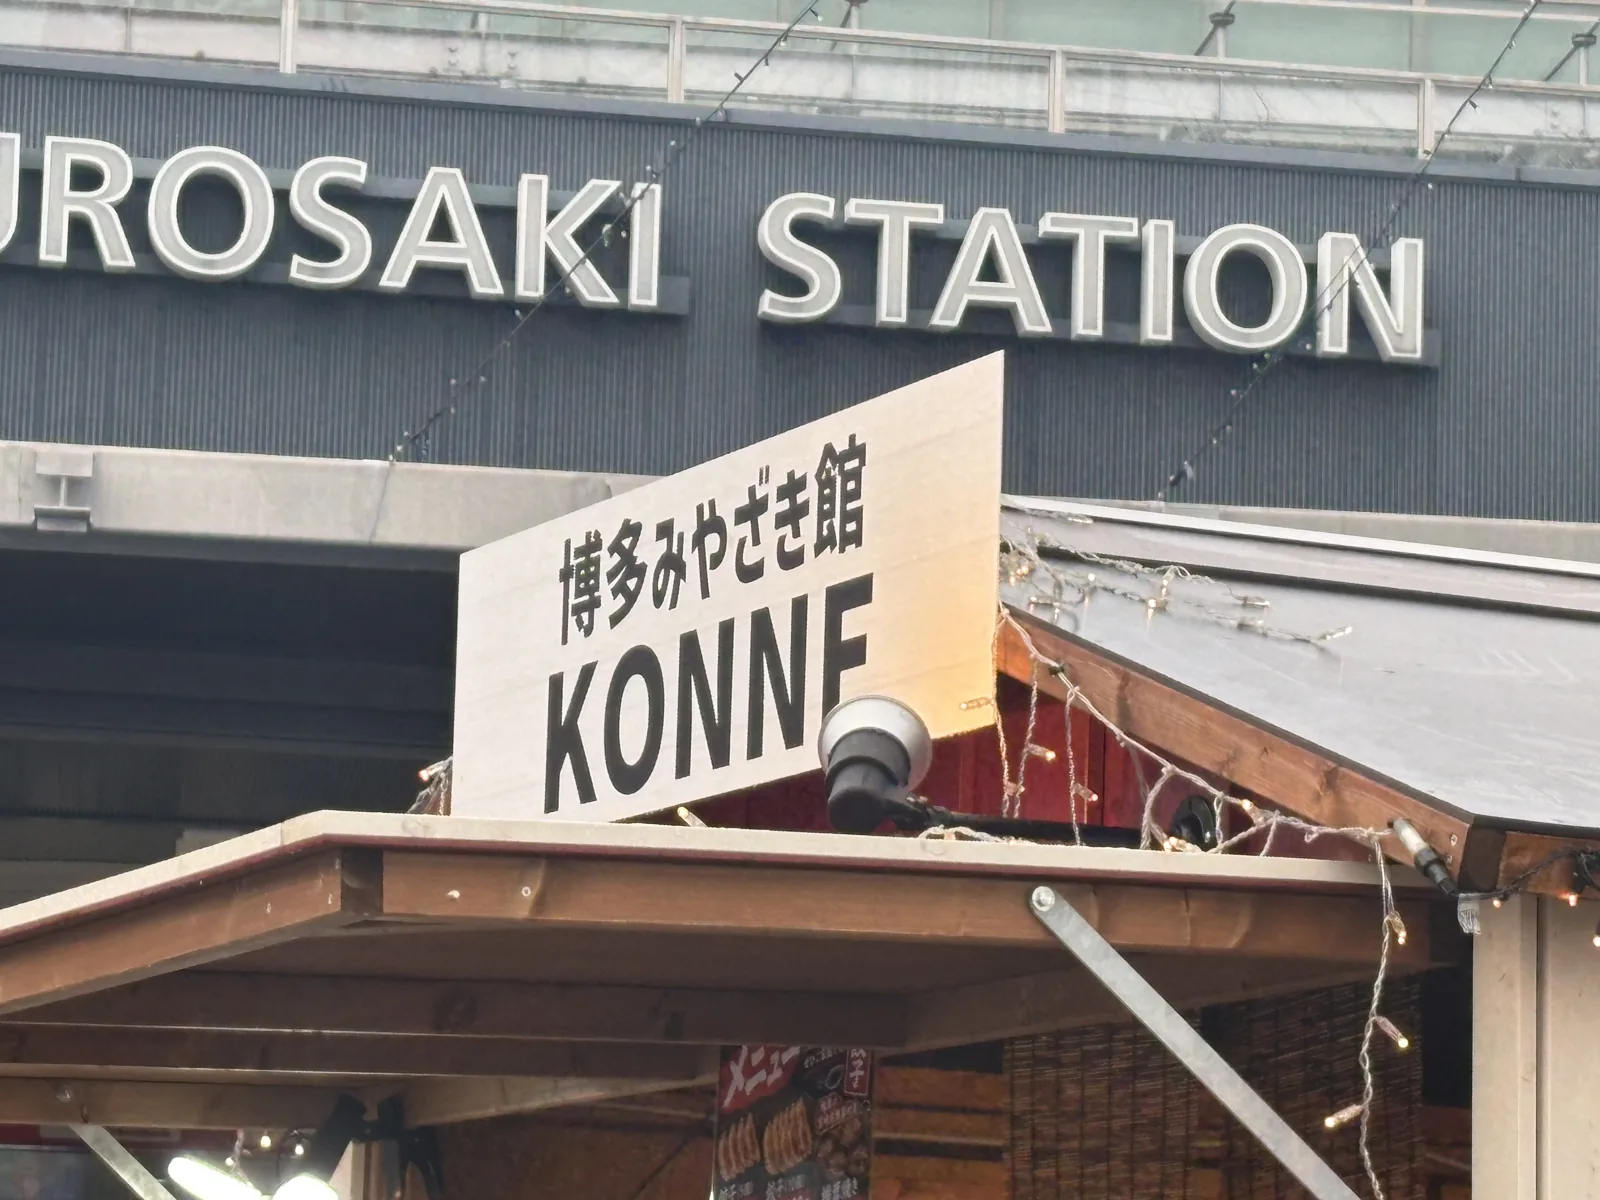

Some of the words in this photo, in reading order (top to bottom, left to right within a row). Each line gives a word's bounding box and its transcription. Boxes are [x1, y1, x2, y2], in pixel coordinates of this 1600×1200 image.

[0, 132, 662, 309] ROSAKI
[757, 192, 1425, 364] STATION
[559, 433, 867, 646] 博多みやざき館
[722, 1044, 802, 1109] メニュー
